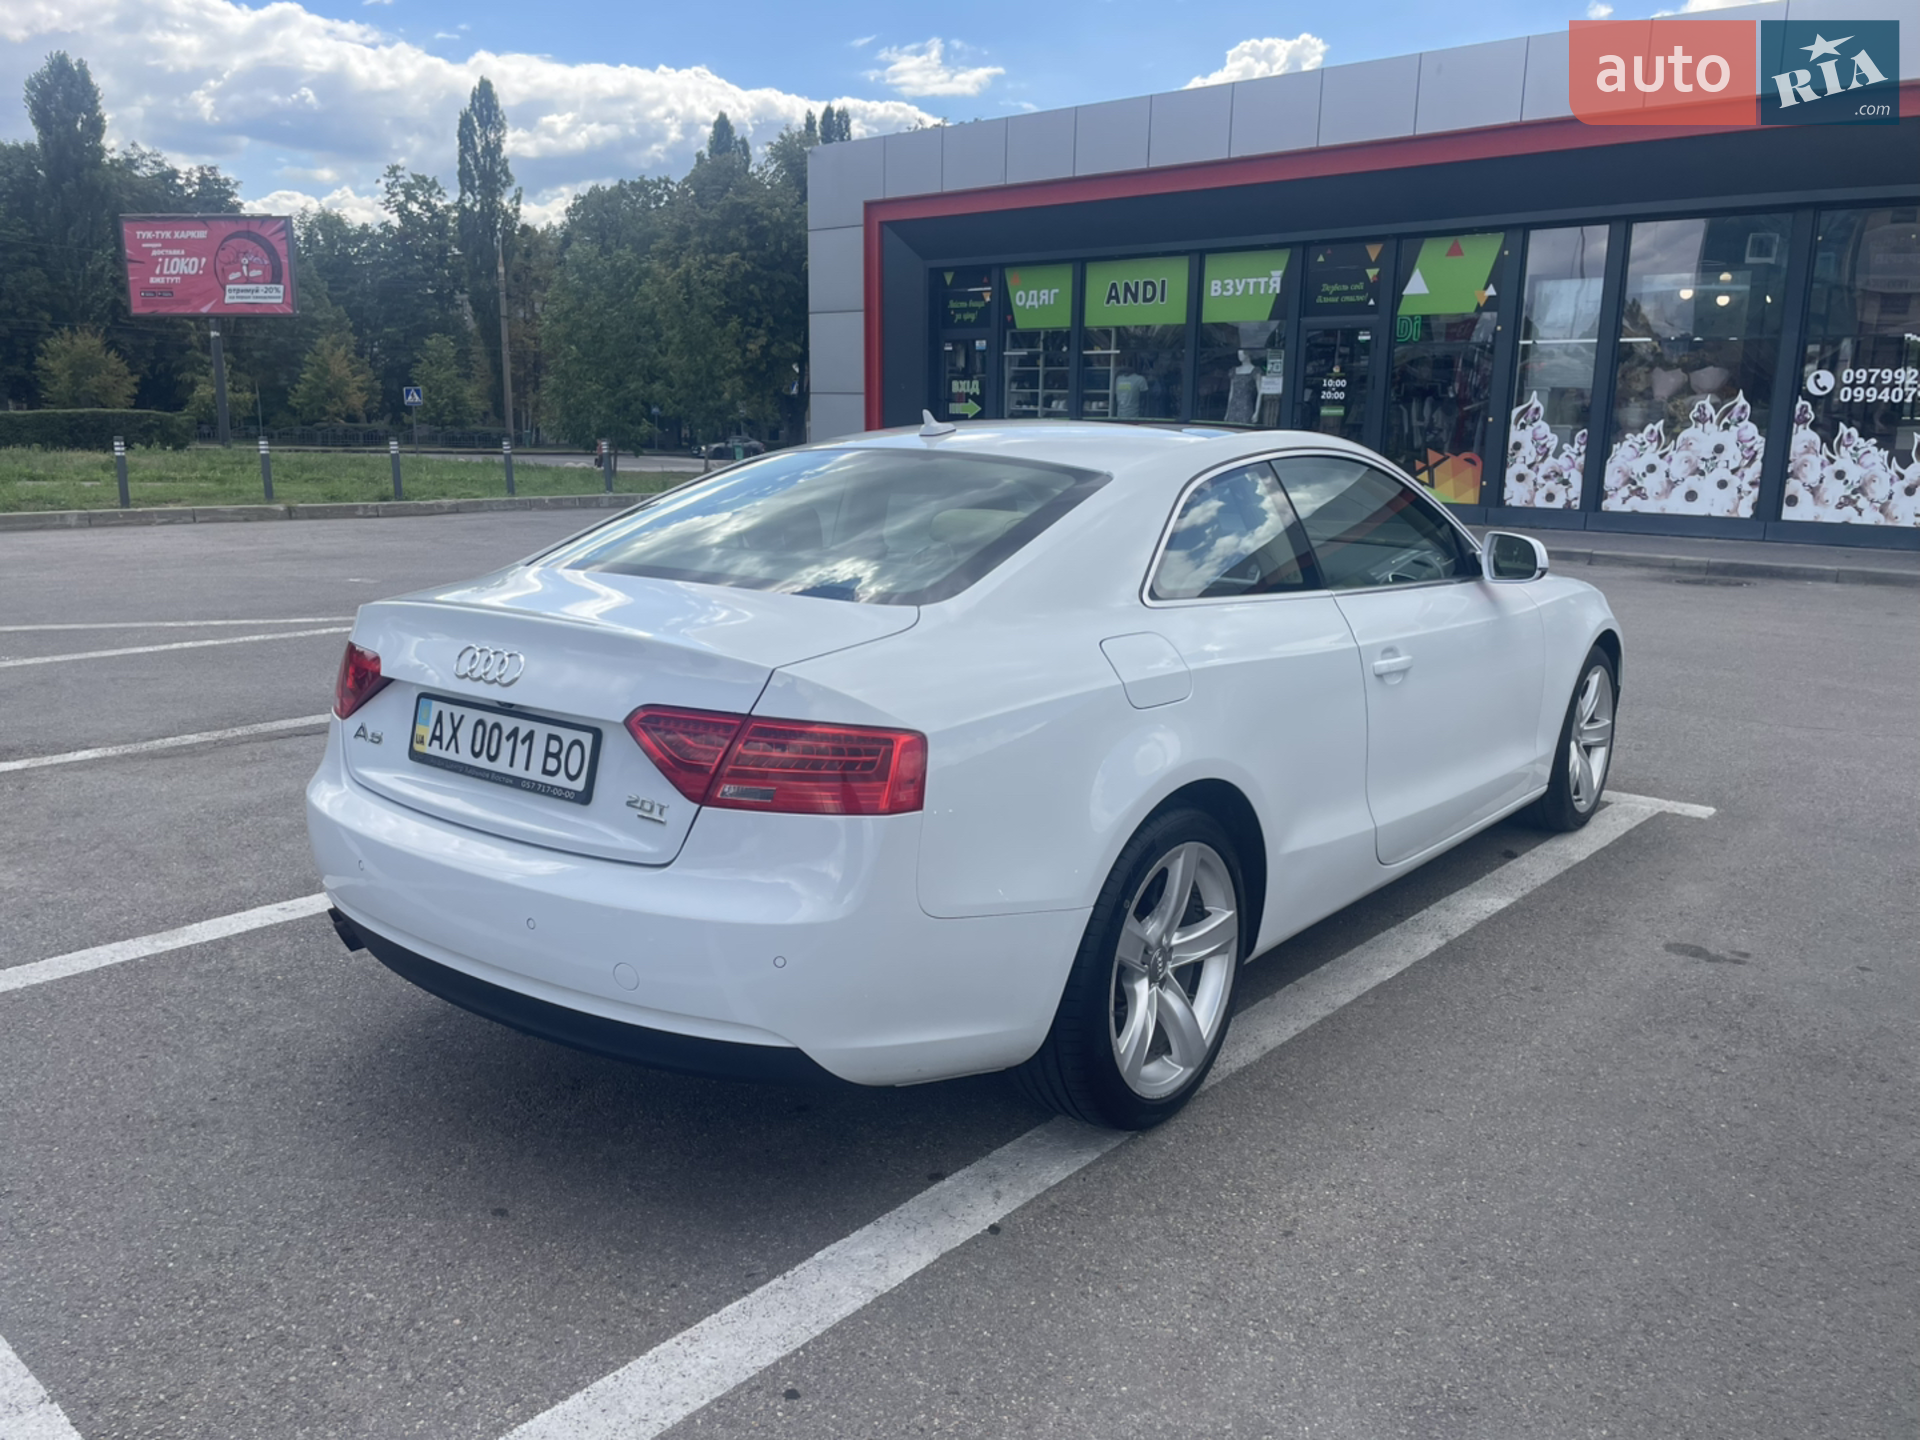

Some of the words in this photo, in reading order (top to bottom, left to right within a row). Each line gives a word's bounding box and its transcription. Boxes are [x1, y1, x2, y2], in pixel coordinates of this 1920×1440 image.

[136, 230, 172, 239] ТУК-ТУК
[1104, 279, 1168, 307] ANDI
[1210, 275, 1281, 297] ВЗУТТЯ
[1015, 289, 1059, 309] ОДЯГ
[1322, 379, 1347, 387] 10:00
[1841, 368, 1919, 385] 097992
[952, 380, 980, 395] ВХІД
[1320, 391, 1345, 400] 20:00
[1839, 386, 1920, 403] 099407
[471, 718, 535, 772] 0011
